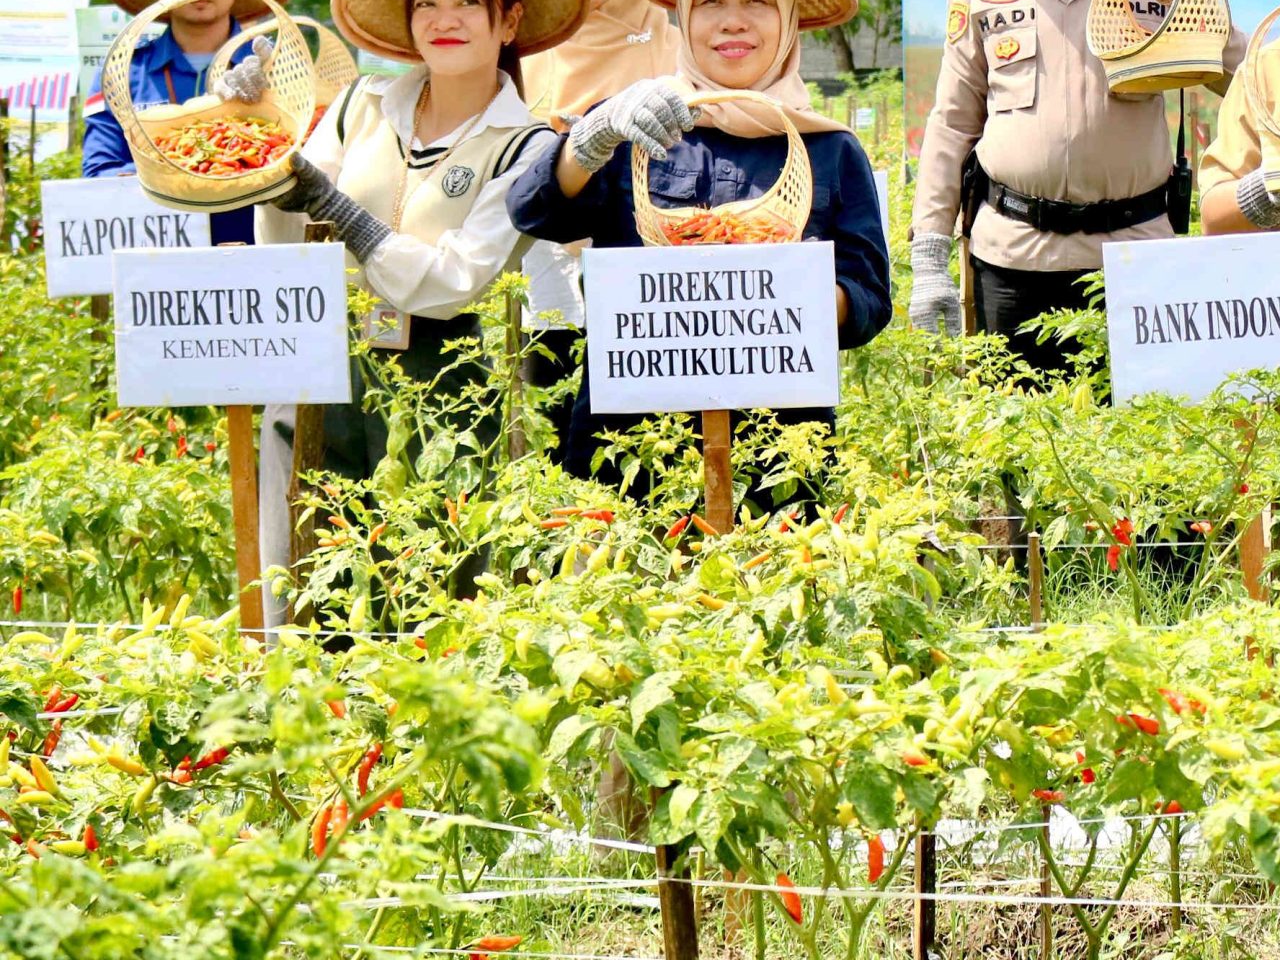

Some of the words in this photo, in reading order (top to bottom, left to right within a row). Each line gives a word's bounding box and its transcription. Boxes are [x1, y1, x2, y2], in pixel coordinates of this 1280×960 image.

[978, 7, 1036, 32] HADI
[59, 213, 193, 257] KAPOLSEK
[638, 269, 776, 303] DIREKTUR
[131, 288, 264, 327] DIREKTUR
[275, 286, 326, 323] STO
[616, 307, 803, 339] PELINDUNGAN
[1133, 302, 1201, 345] BANK
[162, 337, 297, 359] KEMENTAN
[607, 345, 815, 379] HORTIKULTURA
